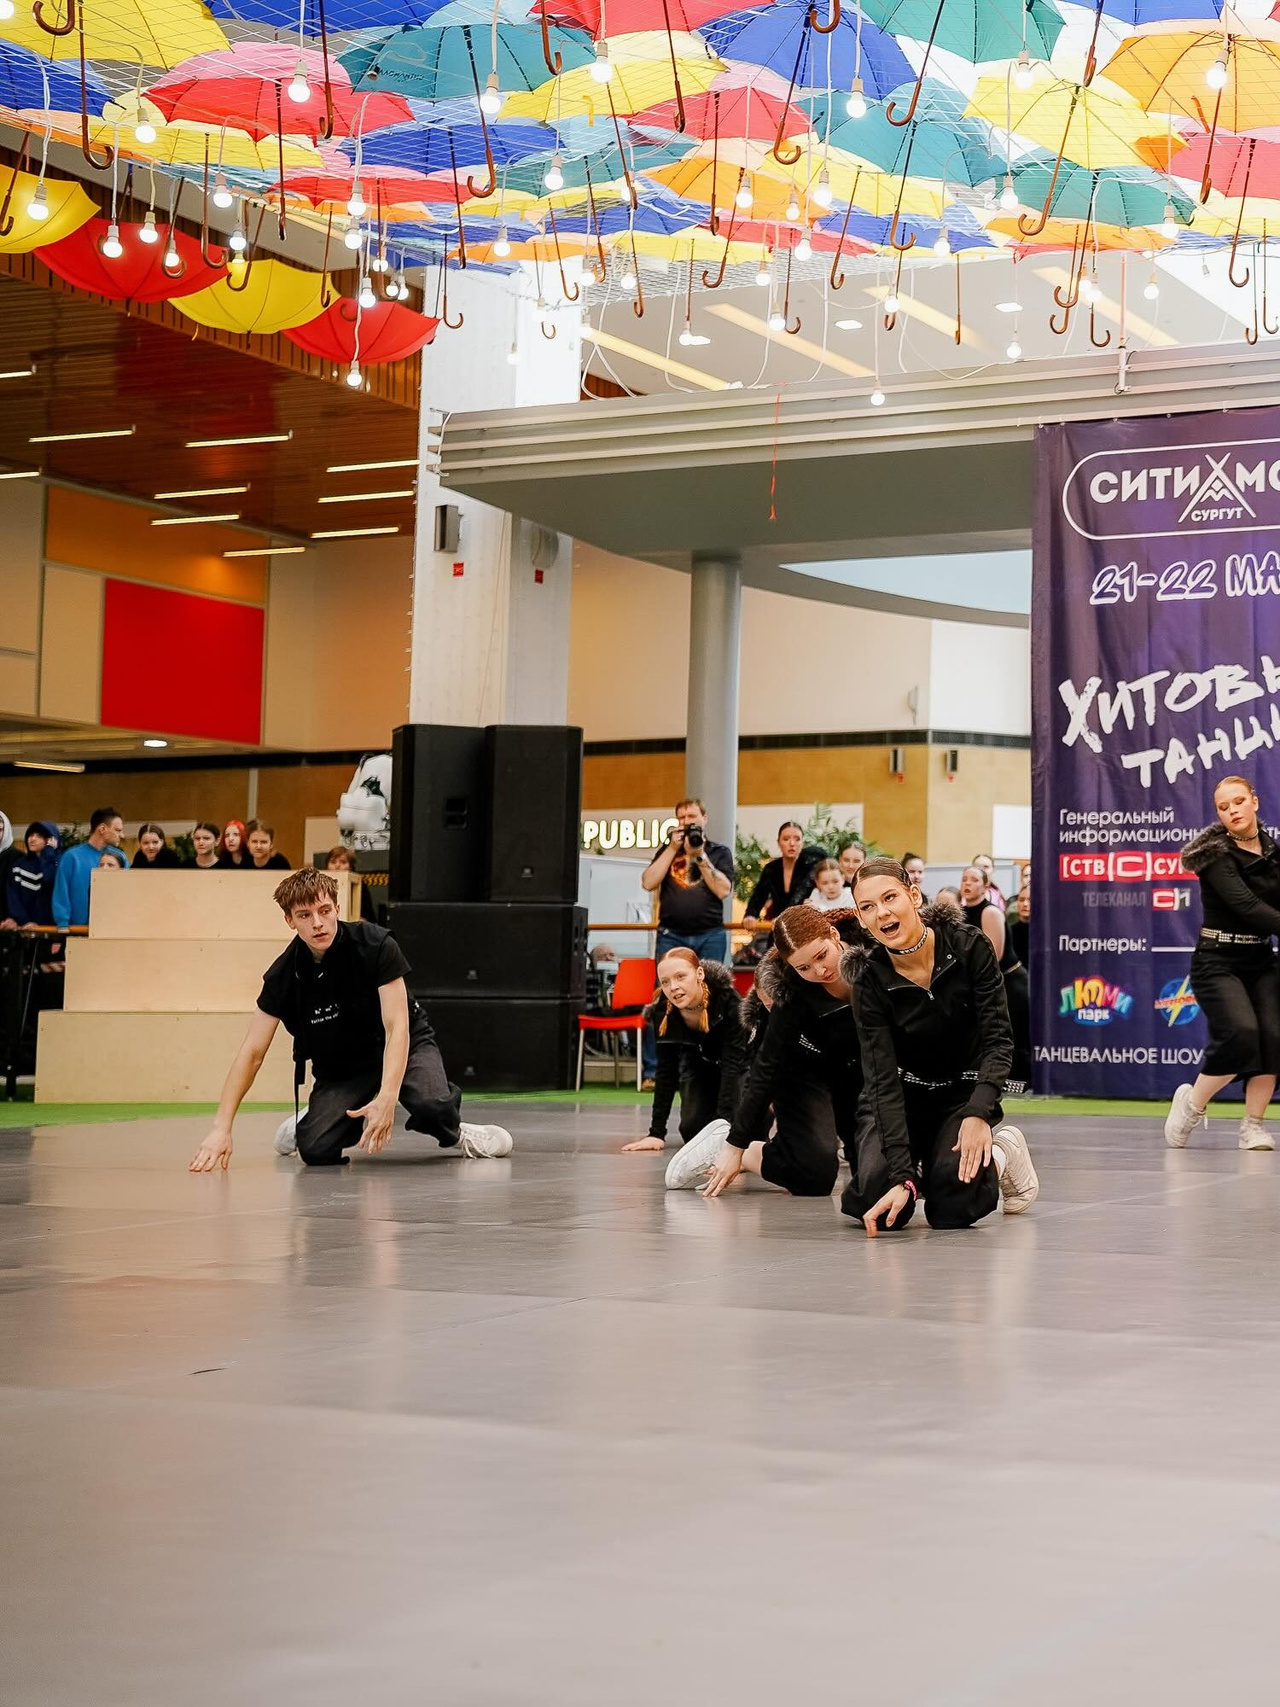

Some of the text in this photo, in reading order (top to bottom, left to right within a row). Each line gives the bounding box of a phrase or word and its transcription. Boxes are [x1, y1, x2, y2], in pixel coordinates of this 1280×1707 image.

[1190, 506, 1244, 522] СУРГУТ
[1089, 560, 1218, 606] 21-22
[1059, 806, 1175, 828] Генеральный
[1059, 934, 1147, 955] Партнеры:
[1033, 1046, 1158, 1065] ТАНЦЕВАЛЬНОЕ
[1161, 1047, 1205, 1065] ШОУ
